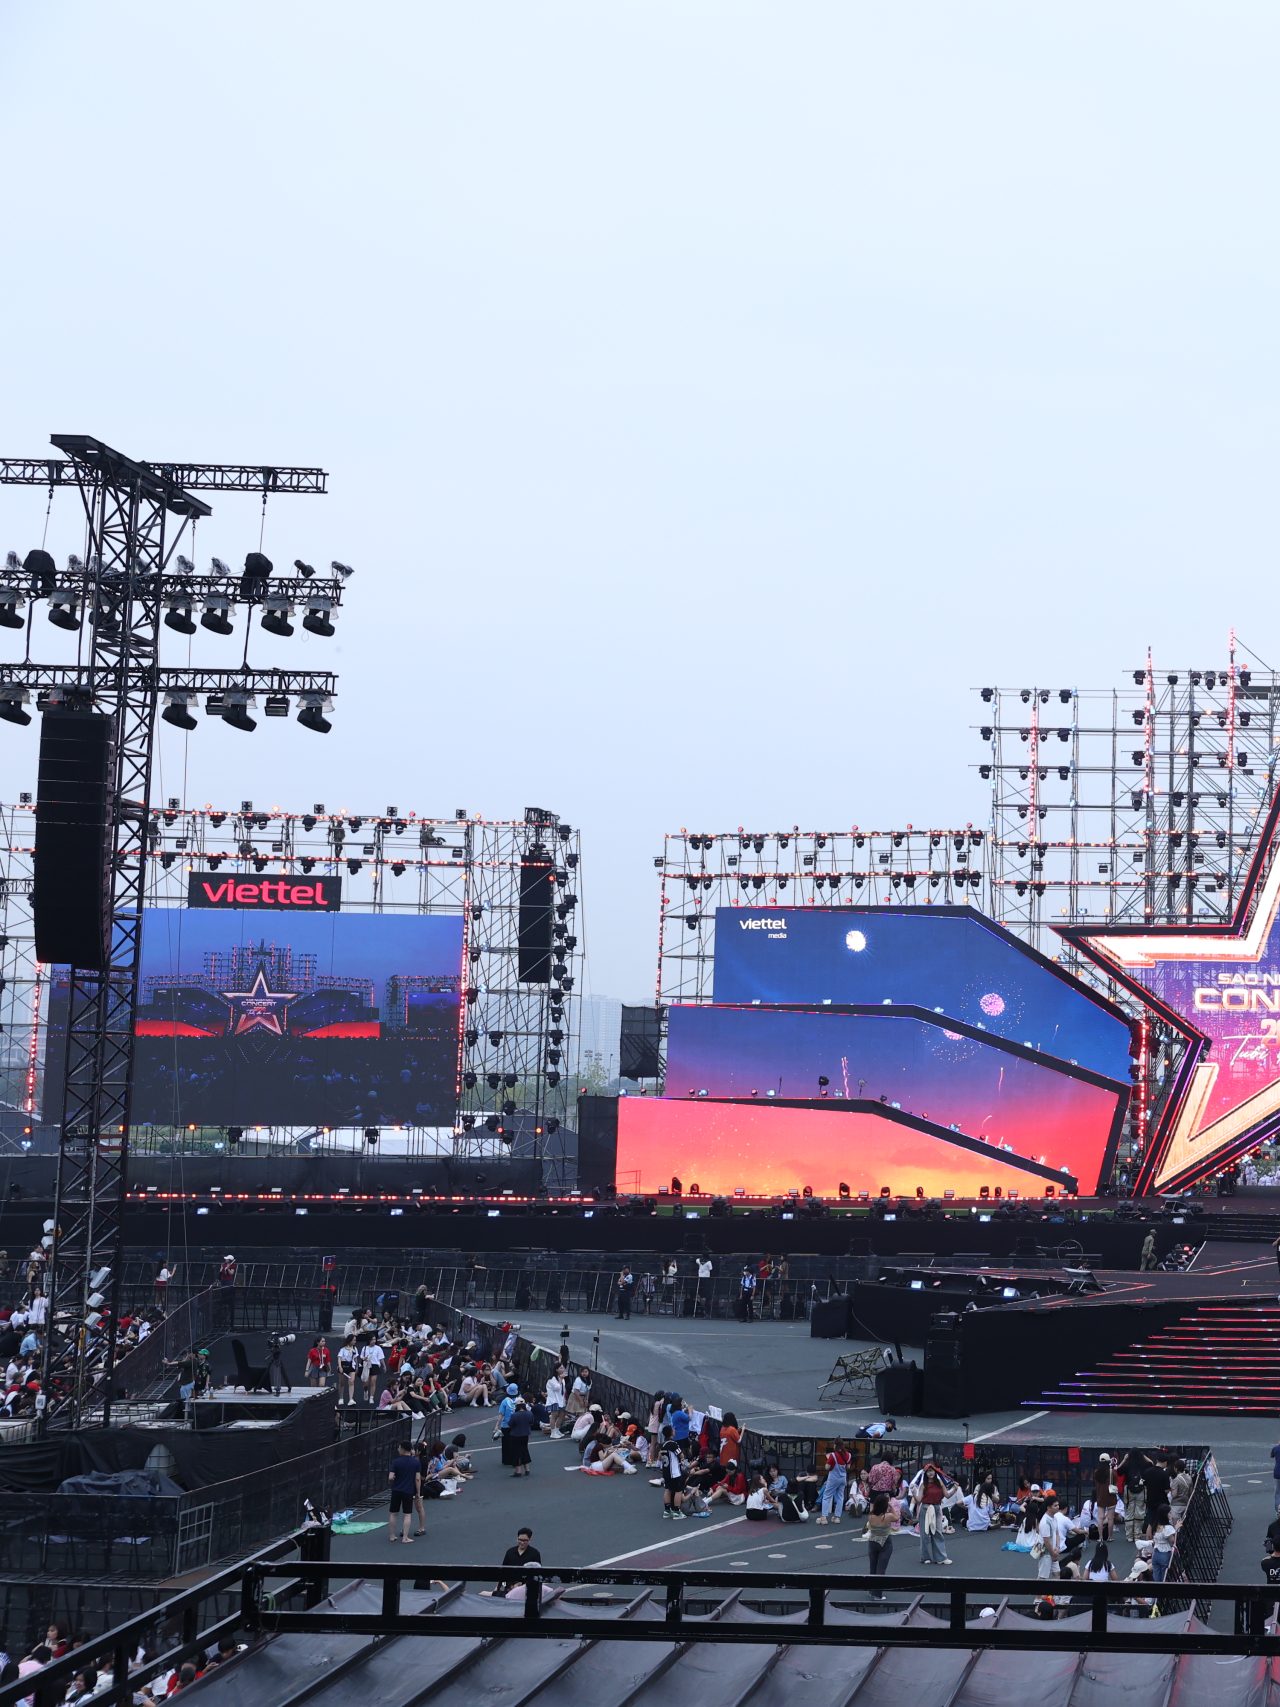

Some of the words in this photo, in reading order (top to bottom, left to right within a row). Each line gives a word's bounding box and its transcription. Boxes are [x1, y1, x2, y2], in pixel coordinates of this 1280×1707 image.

[202, 878, 328, 905] viettel
[739, 918, 787, 930] viettel
[1217, 973, 1259, 985] SAO
